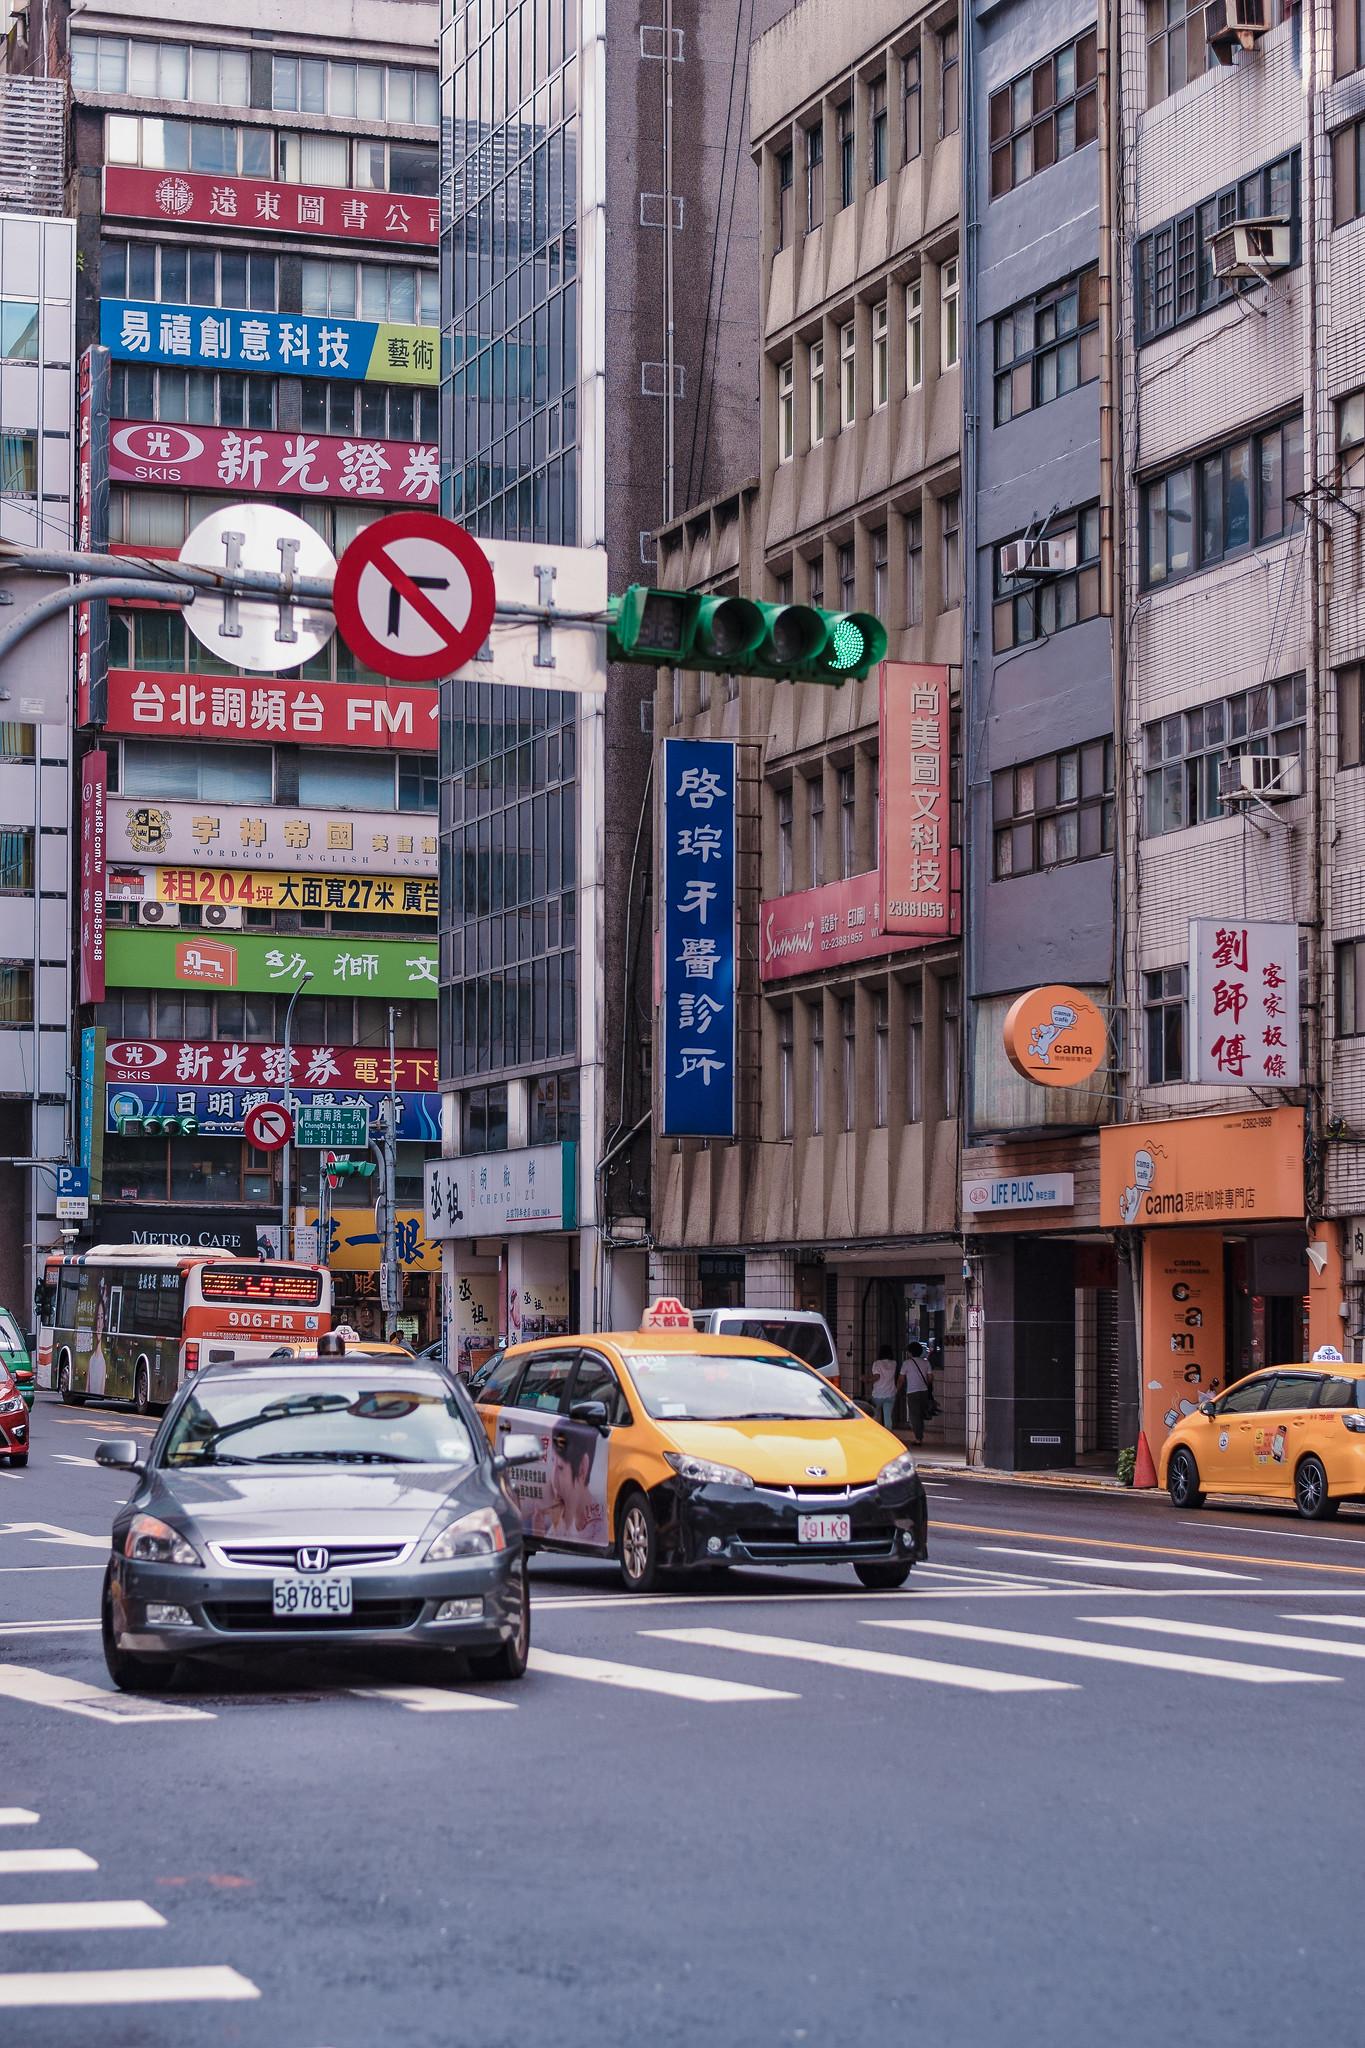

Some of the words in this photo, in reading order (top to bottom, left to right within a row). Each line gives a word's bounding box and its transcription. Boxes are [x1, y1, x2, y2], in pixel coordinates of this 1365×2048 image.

[387, 337, 434, 370] 藝術
[134, 466, 181, 481] SKIS
[217, 430, 439, 500] 新光證券
[131, 681, 325, 732] 台北調頻台
[346, 698, 413, 734] FM
[192, 815, 354, 850] 字神帝國
[193, 849, 275, 860] WORDGOD
[296, 854, 369, 864] ENGLISH
[888, 901, 944, 918] 23881955
[265, 950, 438, 983] 幼獅文
[1211, 928, 1252, 1077] 劉師傅
[1054, 1045, 1092, 1055] cama
[176, 1043, 341, 1086] 新光證券
[117, 1070, 151, 1079] SKIS
[304, 1109, 361, 1121] 重慶南路一段
[60, 1168, 73, 1187] P
[991, 1183, 1008, 1204] LIFE
[1011, 1181, 1034, 1203] PLUS
[1145, 1193, 1184, 1215] cama
[132, 1230, 191, 1246] METRO
[198, 1232, 241, 1248] CAFE
[228, 1312, 294, 1329] 906-FR
[648, 1316, 690, 1327] 大都會
